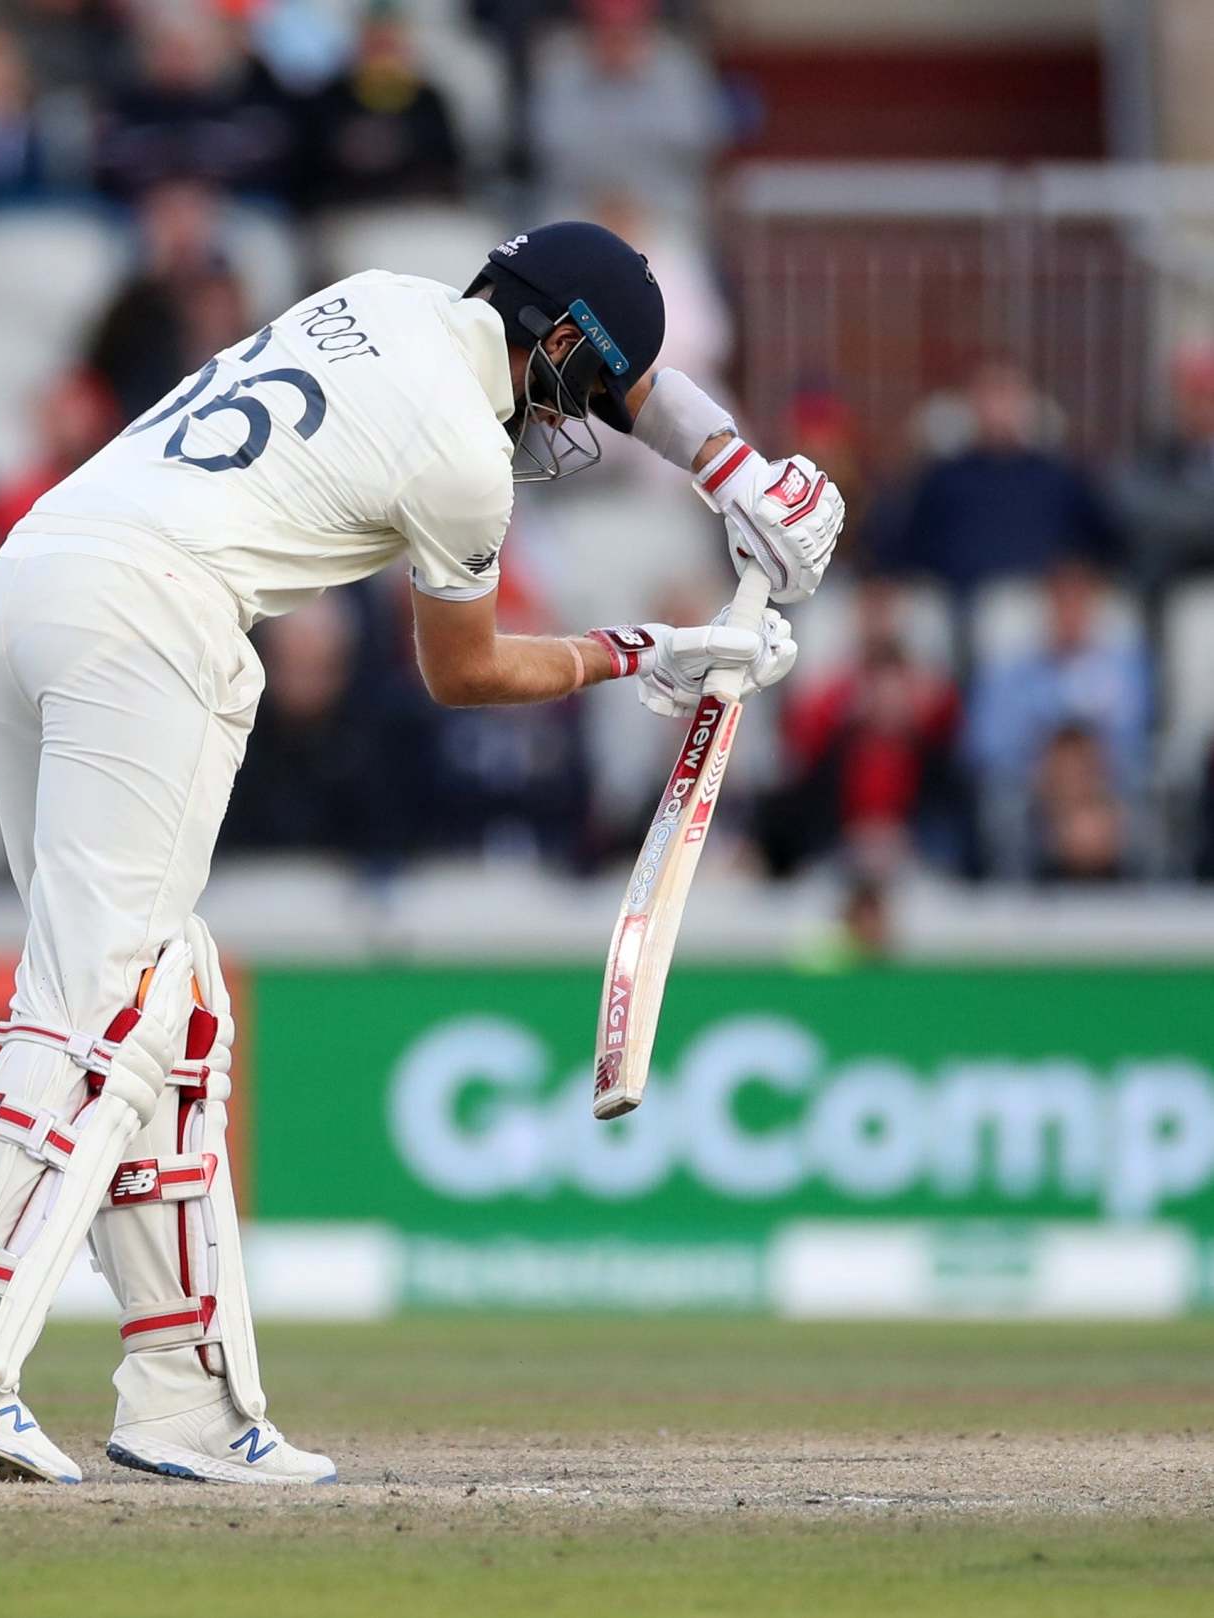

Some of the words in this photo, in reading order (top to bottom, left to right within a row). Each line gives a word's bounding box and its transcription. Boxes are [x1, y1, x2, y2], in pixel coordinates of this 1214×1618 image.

[296, 298, 380, 363] ROOT
[589, 326, 611, 353] AIR
[684, 709, 719, 769] new
[632, 778, 695, 905] balance
